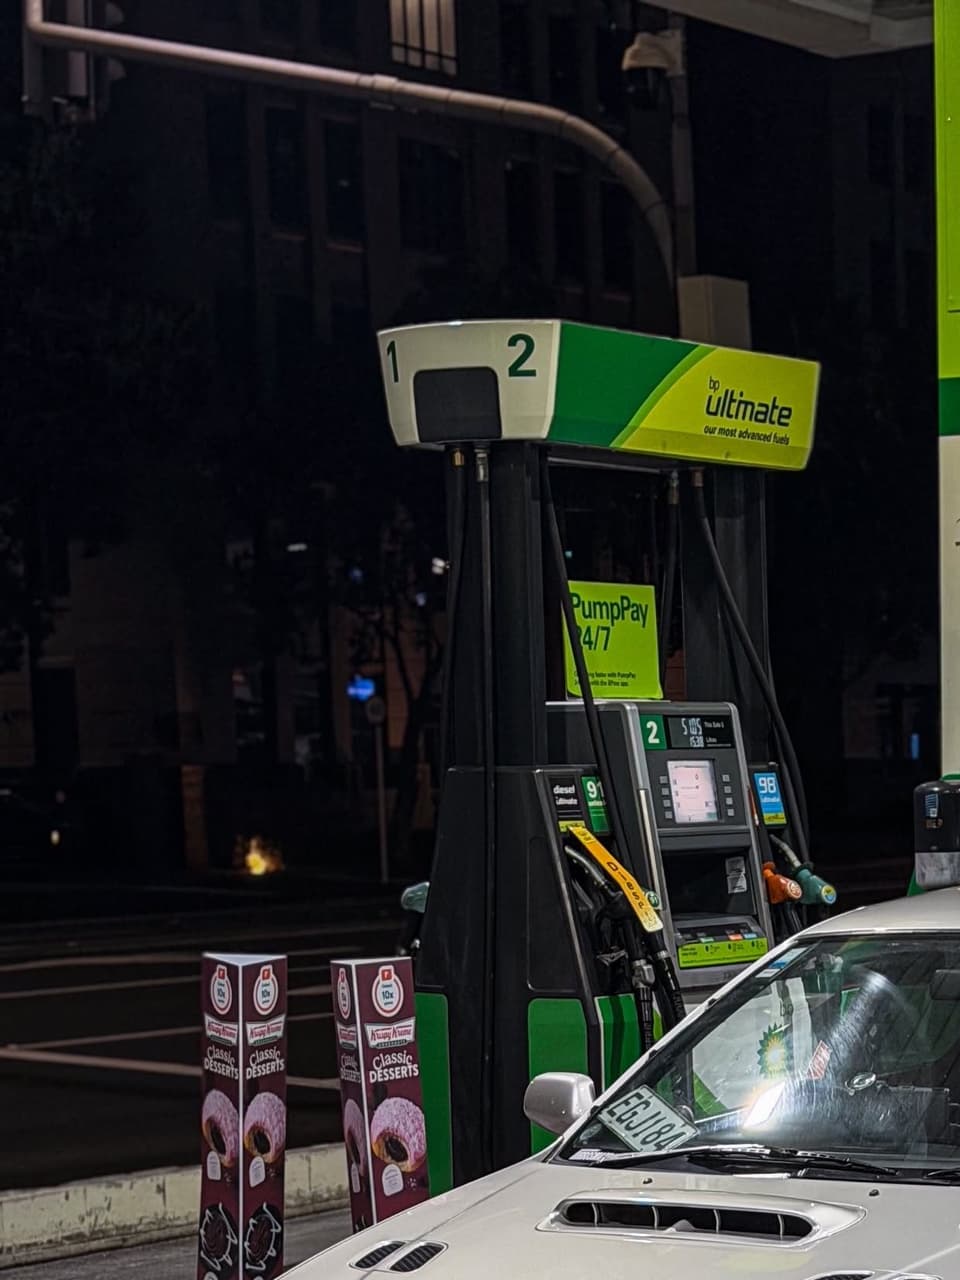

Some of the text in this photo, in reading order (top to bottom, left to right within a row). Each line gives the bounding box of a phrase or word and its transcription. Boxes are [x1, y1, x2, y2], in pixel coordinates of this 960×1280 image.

[386, 340, 399, 384] 1
[507, 333, 537, 378] 2
[709, 375, 720, 392] bp
[706, 388, 792, 427] ultimate
[704, 425, 789, 445] our most advanced fuels
[646, 720, 660, 744] 2
[586, 780, 605, 799] 91
[758, 776, 777, 793] 98
[381, 989, 394, 1000] 10x
[371, 1028, 392, 1042] Krispy
[391, 1024, 413, 1039] Kreme
[207, 1045, 236, 1066] Classic
[249, 1046, 281, 1067] Classic
[372, 1050, 413, 1071] Classic
[203, 1057, 239, 1080] DESSERTS
[246, 1058, 285, 1080] DESSERTS
[369, 1063, 419, 1084] DESSERTS
[606, 1091, 687, 1151] EGJ184
